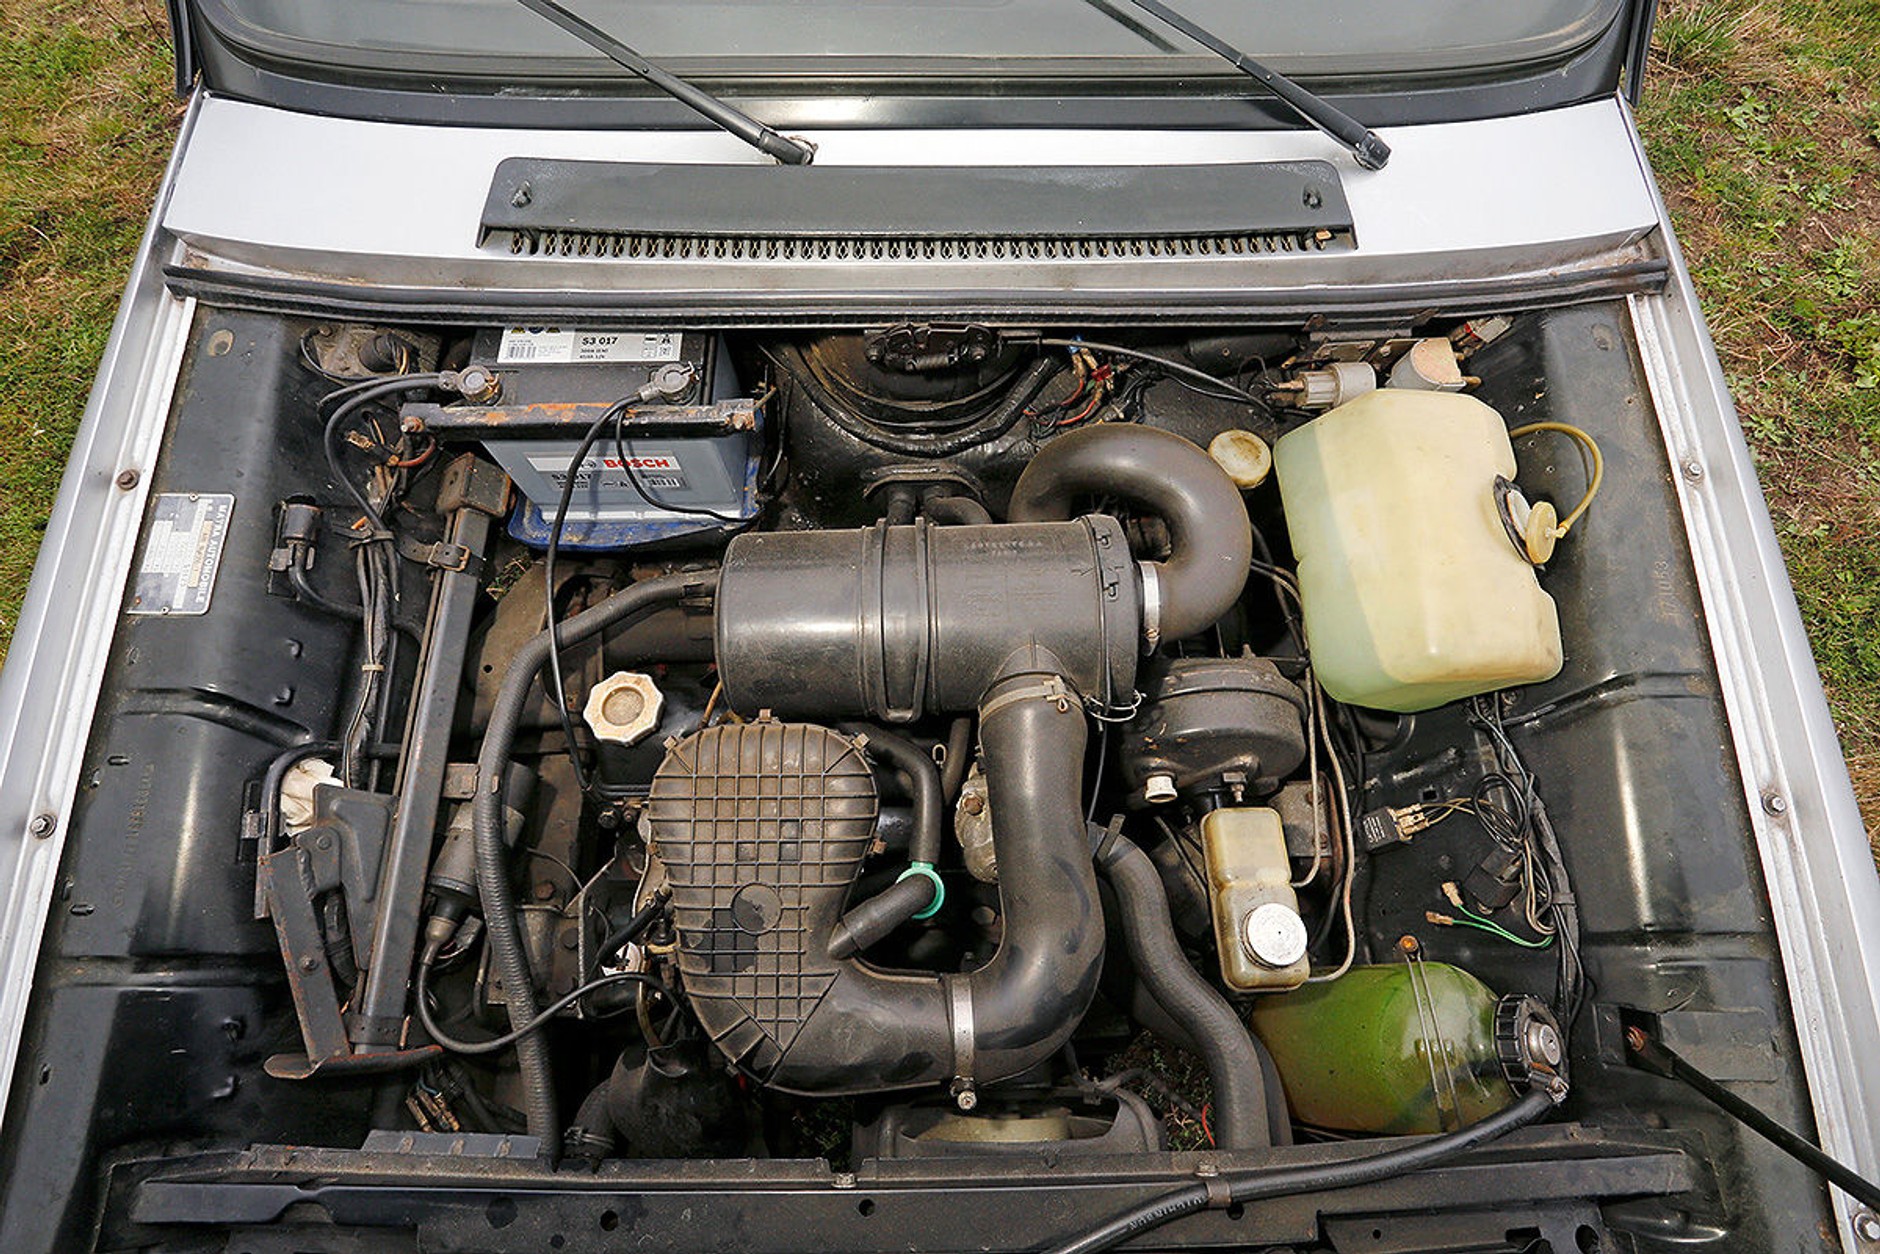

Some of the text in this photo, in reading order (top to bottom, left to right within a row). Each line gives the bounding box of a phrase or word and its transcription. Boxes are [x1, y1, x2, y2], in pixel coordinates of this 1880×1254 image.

[604, 458, 670, 468] BOSCH
[213, 504, 227, 537] MATRA
[196, 539, 219, 604] AUTOMOBILE
